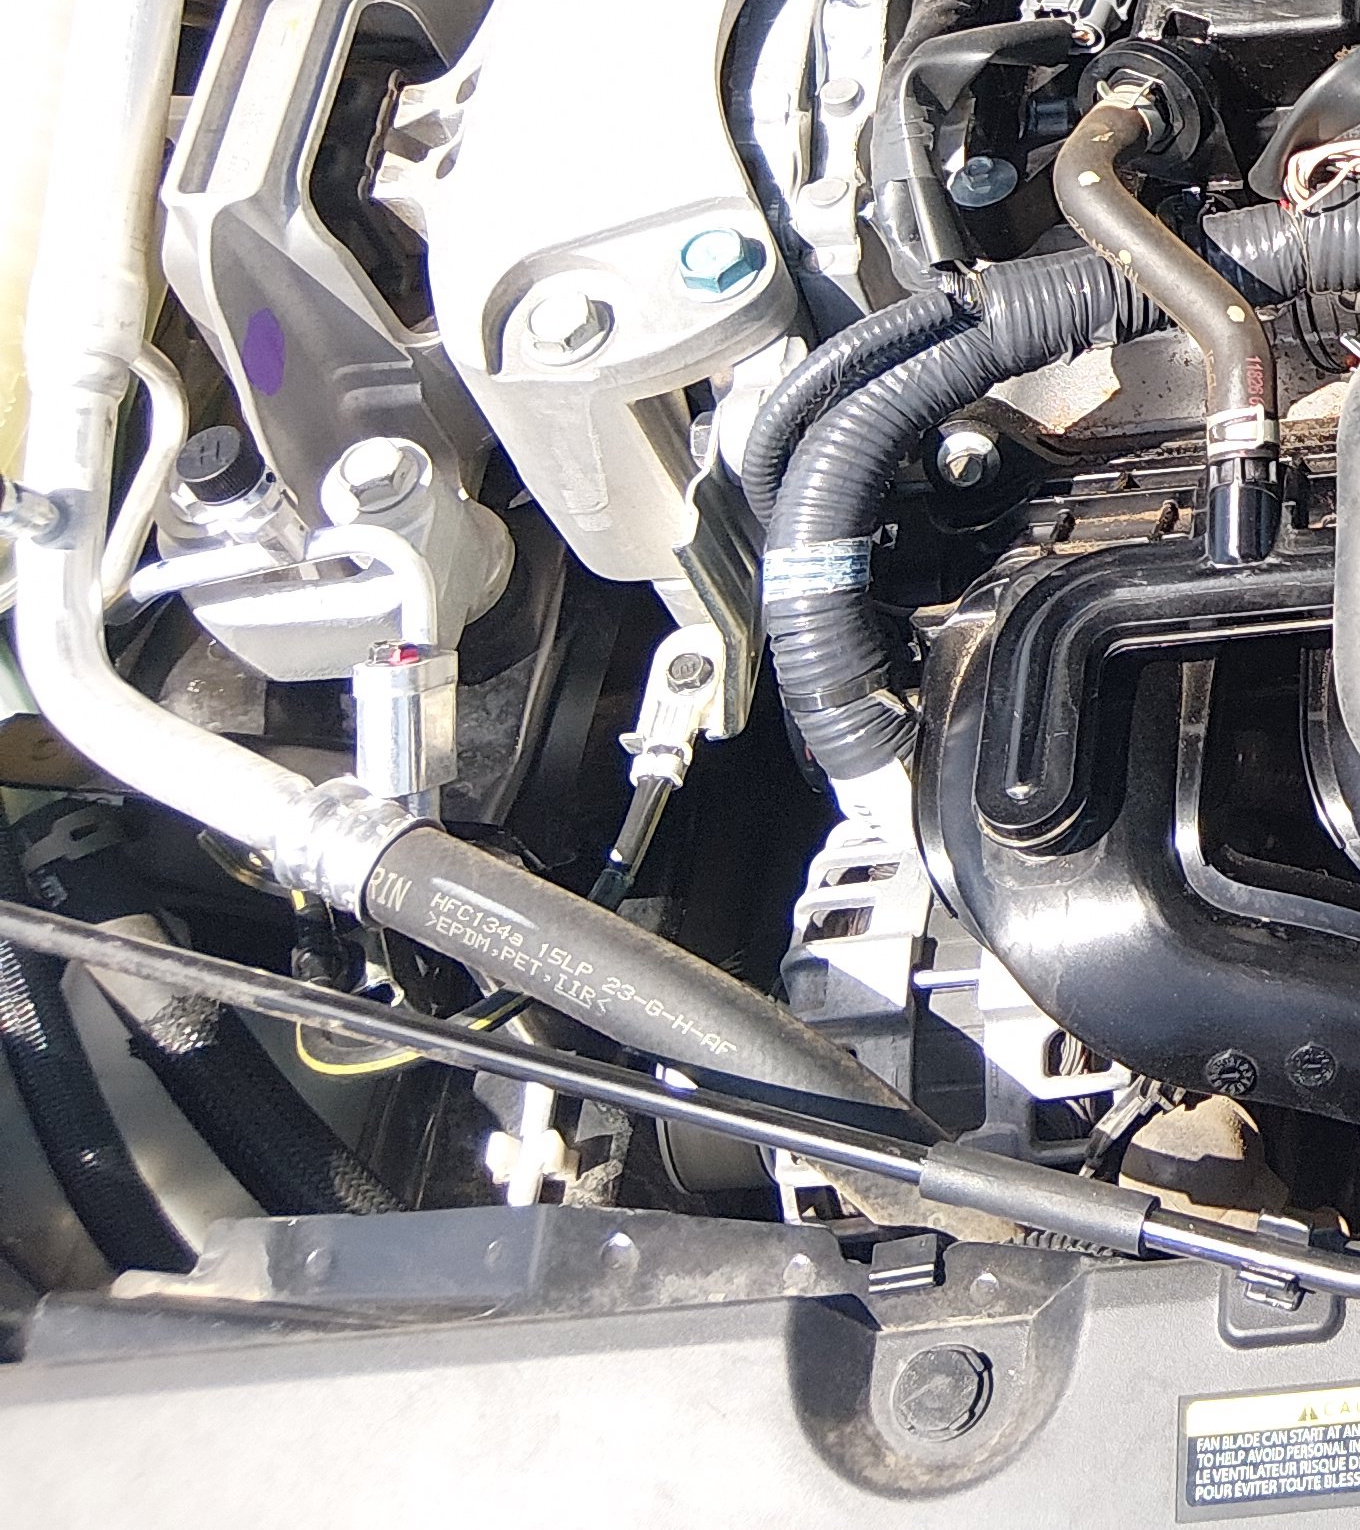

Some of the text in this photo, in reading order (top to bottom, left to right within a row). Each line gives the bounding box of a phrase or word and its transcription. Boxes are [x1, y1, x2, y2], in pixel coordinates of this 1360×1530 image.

[430, 891, 525, 947] HFC134a
[1196, 1436, 1221, 1453] FAN
[1221, 1432, 1260, 1451] BLADE
[1261, 1430, 1288, 1447] CAN
[1289, 1426, 1325, 1443] START
[1326, 1424, 1343, 1440] AT
[1197, 1453, 1215, 1469] TO
[1216, 1450, 1245, 1466] HELP
[1246, 1446, 1285, 1464] AVOID
[1286, 1441, 1347, 1461] PERSONAL
[1196, 1469, 1211, 1485] LE
[1212, 1460, 1298, 1483] VENTILATEUR
[1299, 1458, 1347, 1476] RISQUE
[1195, 1486, 1233, 1501] POUR
[1234, 1479, 1277, 1498] ÉVITER
[1278, 1477, 1321, 1494] TOUTE
